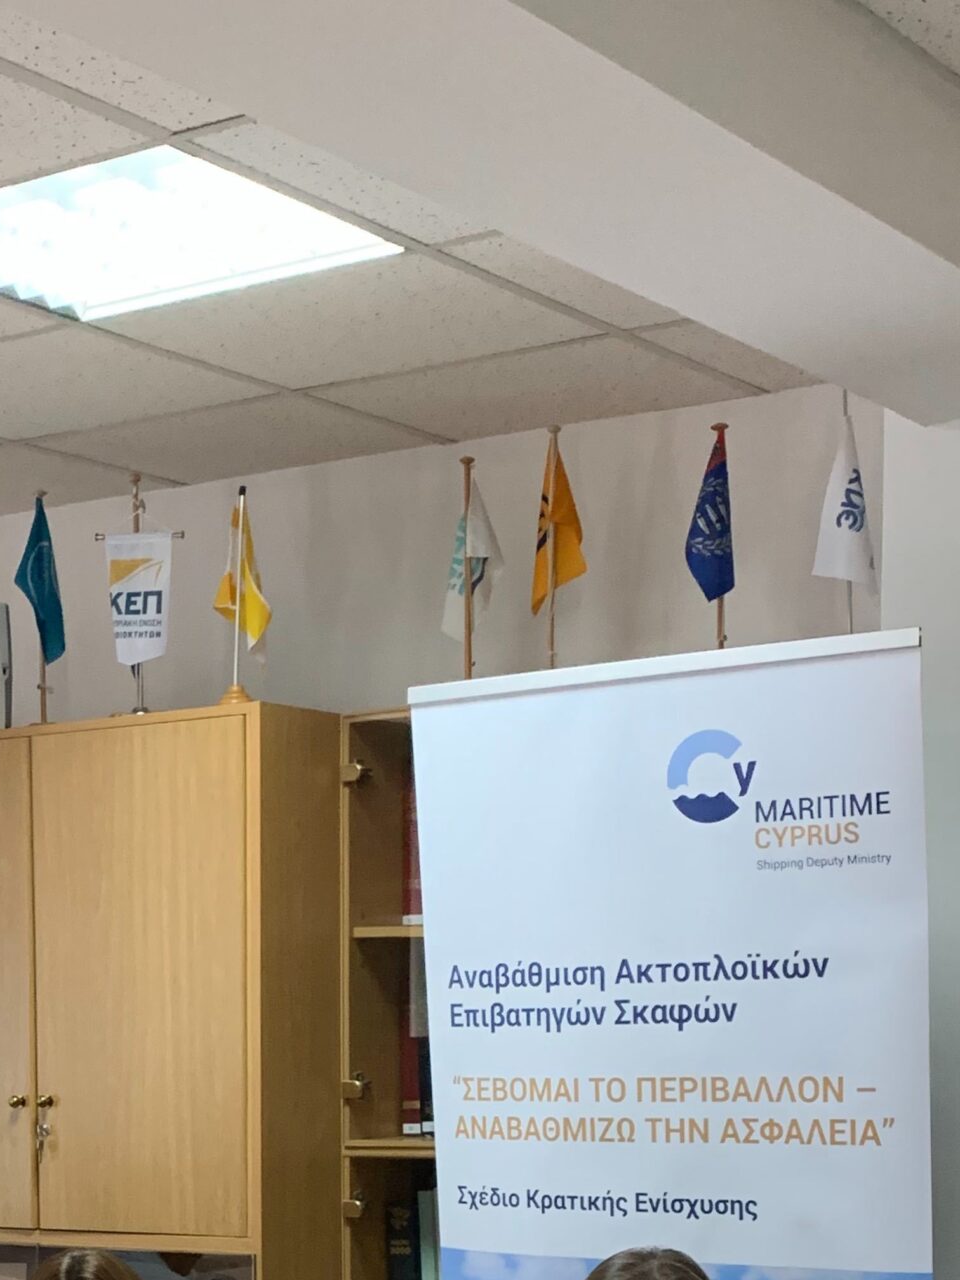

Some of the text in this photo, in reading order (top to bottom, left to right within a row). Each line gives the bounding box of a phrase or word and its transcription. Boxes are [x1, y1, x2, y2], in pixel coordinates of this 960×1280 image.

[755, 791, 891, 823] MARITIME
[755, 822, 860, 849] CYPRUS
[756, 853, 892, 871] Shipping Deputy Ministry
[448, 950, 829, 994] Αναβάθμιση Ακτοπλοϊκών
[450, 996, 738, 1033] Επιβατηγών Σκαφών
[589, 1077, 627, 1103] ΤΟ
[637, 1076, 844, 1103] ΠΕΡΙΒΑΛΛΟΝ
[455, 1115, 635, 1143] ΑΝΑΒΑΘΜΙΖΩ
[645, 1117, 709, 1143] ΤΗΝ
[457, 1185, 758, 1221] Σχέδιο Κρατικής Ενίσχυσης
